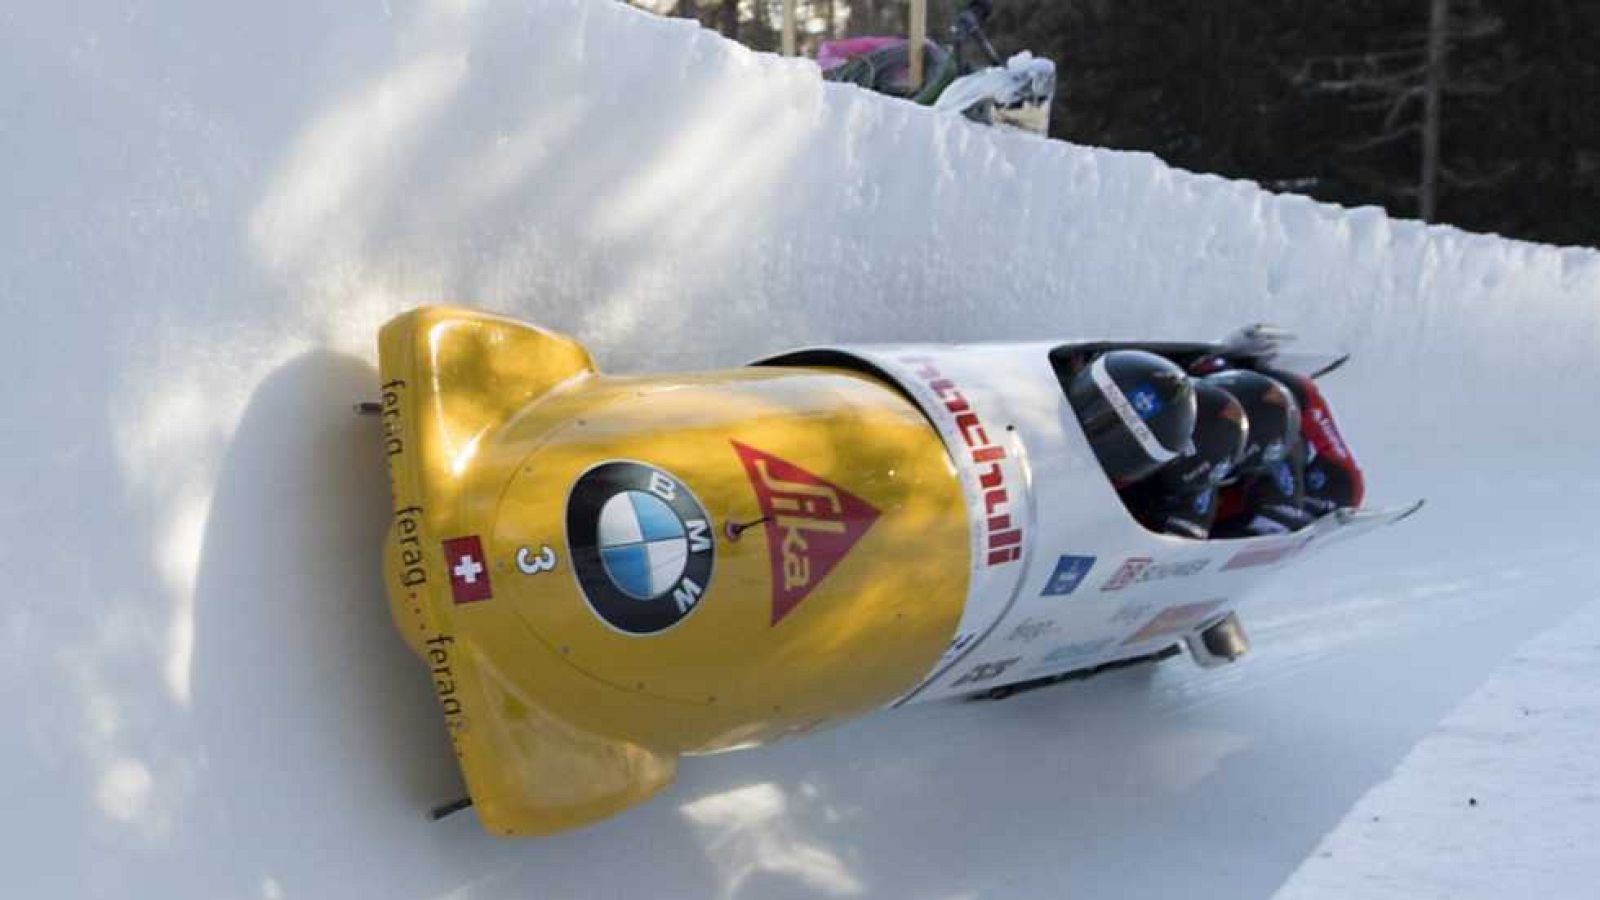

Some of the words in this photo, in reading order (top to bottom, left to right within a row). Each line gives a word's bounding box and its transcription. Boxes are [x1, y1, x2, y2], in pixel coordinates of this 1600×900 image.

[516, 544, 557, 576] 3
[648, 471, 713, 614] BMW
[754, 458, 846, 591] Sika
